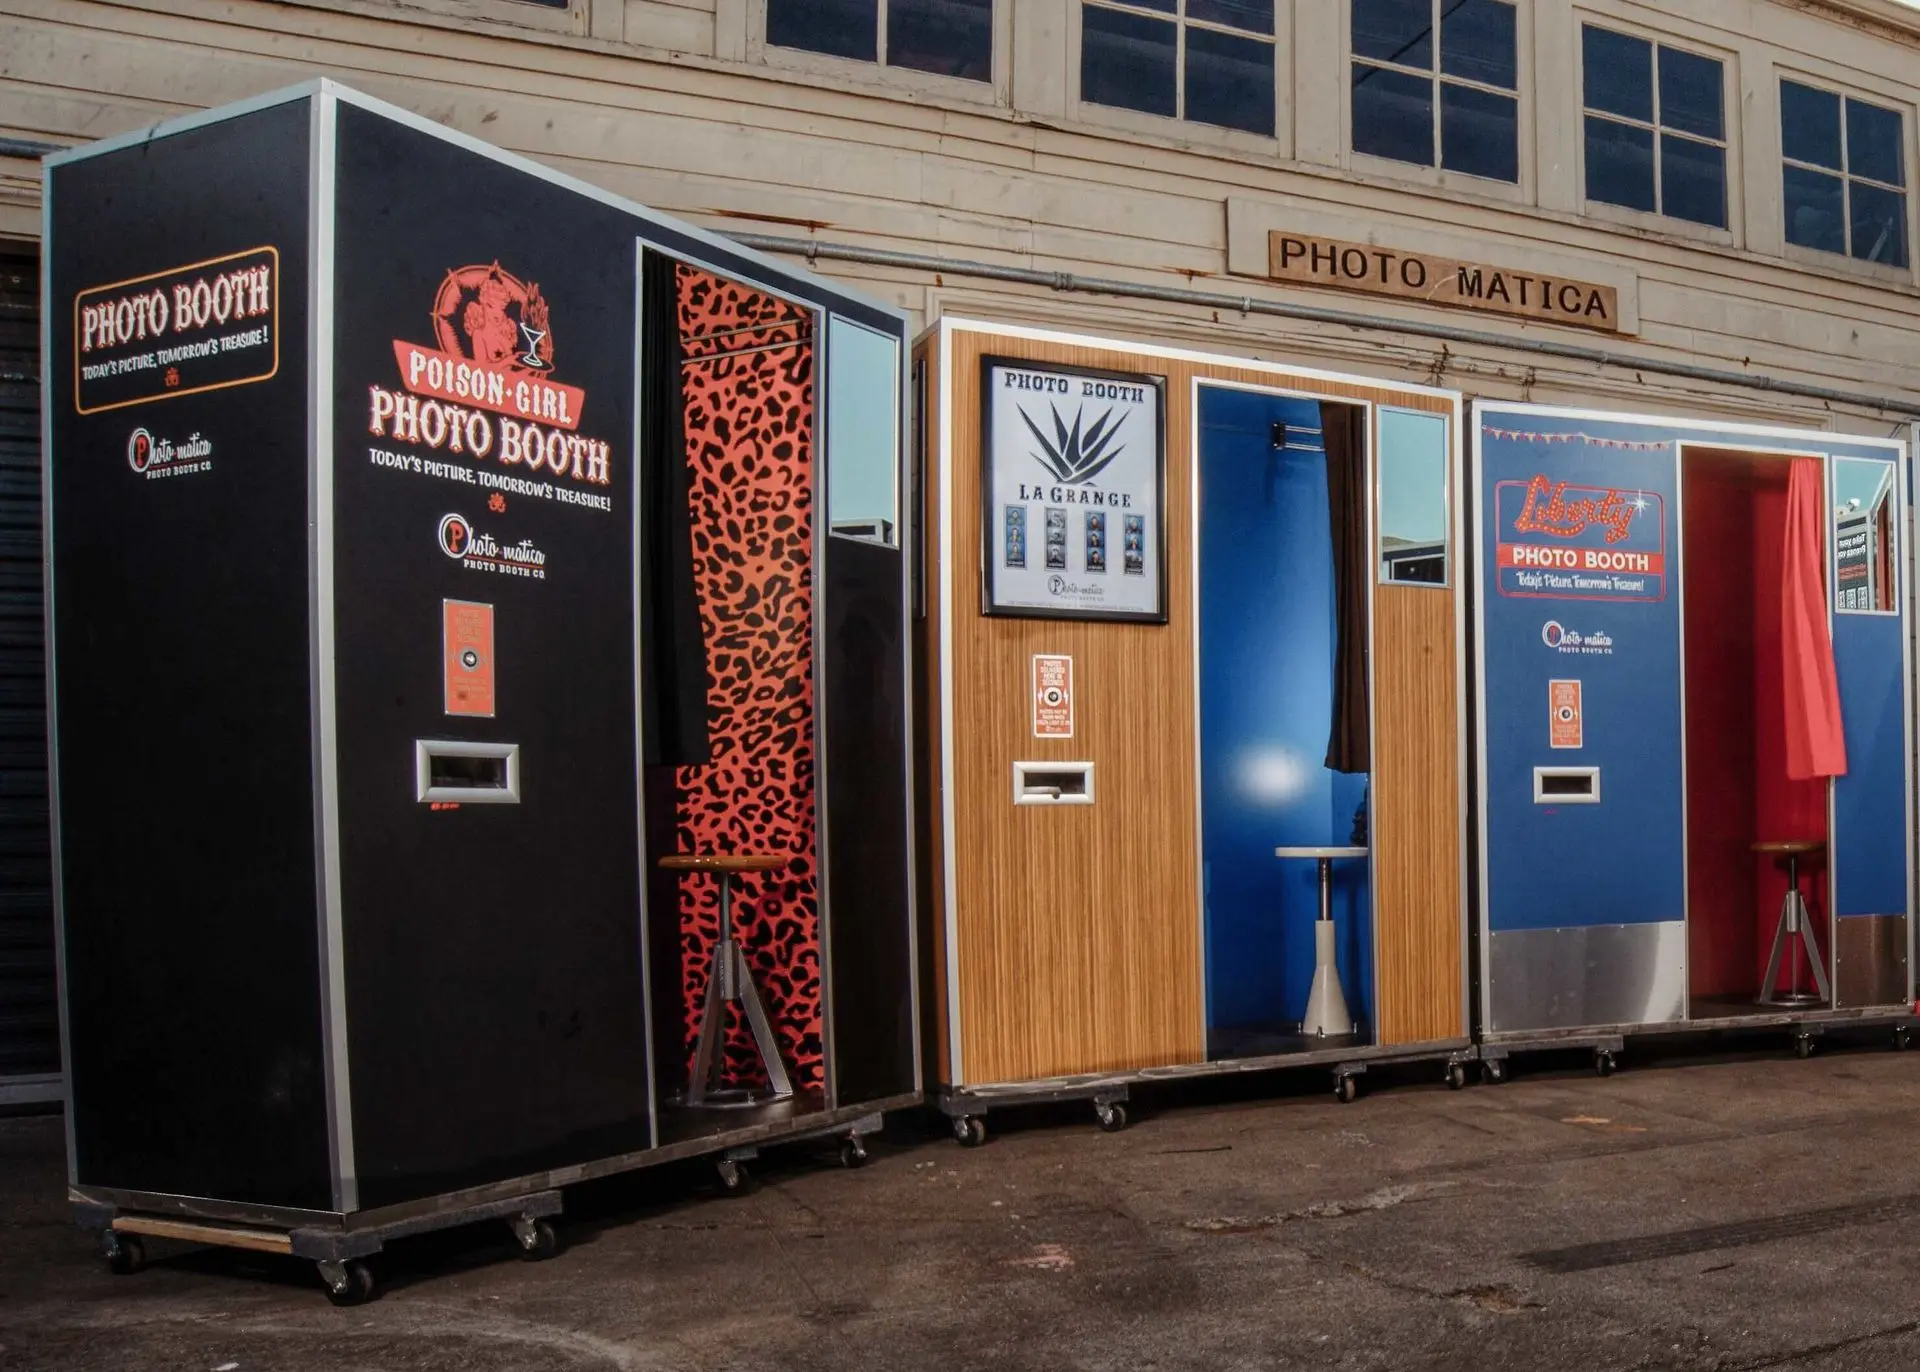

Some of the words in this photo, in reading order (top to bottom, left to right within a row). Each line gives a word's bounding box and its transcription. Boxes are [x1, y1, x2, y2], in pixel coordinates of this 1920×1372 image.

[1280, 237, 1426, 288] PHOTO
[1457, 266, 1607, 319] MATICA
[82, 288, 169, 352] PHOTO
[174, 264, 270, 332] BOOTH
[82, 360, 117, 381] TODAY'S
[118, 352, 157, 373] PICTURE,
[157, 339, 219, 365] TOMORROW'S
[1004, 371, 1069, 393] PHOTO
[1082, 381, 1145, 404] BOOTH
[368, 384, 493, 458] PHOTO
[499, 415, 612, 485] BOOTH
[146, 467, 172, 480] PHOTO
[173, 463, 199, 476] BOOTH
[369, 448, 422, 473] TODAY'S
[424, 459, 476, 485] PICTURE,
[478, 470, 553, 499] TOMORROW'S
[555, 487, 611, 512] TREASURE!
[1514, 472, 1635, 544] Liberty
[464, 558, 496, 572] PHOTO
[499, 564, 530, 577] BOOTH
[1512, 546, 1577, 567] PHOTO
[1585, 551, 1649, 571] BOOTH
